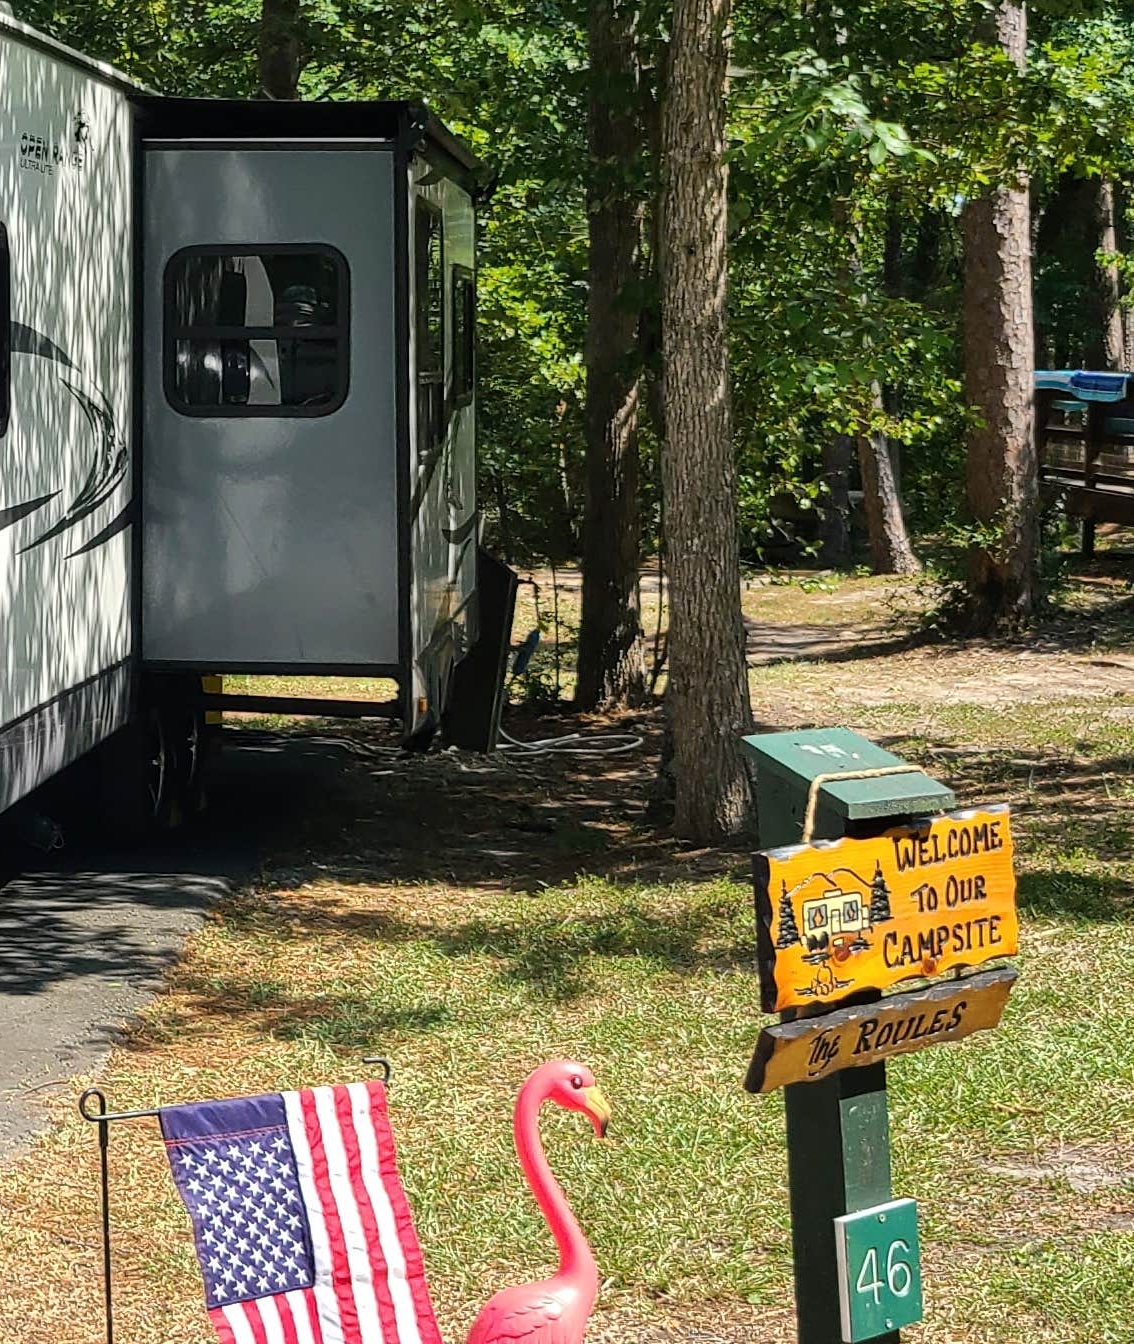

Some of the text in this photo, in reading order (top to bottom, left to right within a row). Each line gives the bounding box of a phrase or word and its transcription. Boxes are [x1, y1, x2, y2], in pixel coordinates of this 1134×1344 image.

[893, 820, 1003, 872] WELCOME
[911, 875, 986, 913] TO OUR
[883, 916, 1002, 968] CAMPSITE
[853, 1001, 967, 1055] ROULES
[855, 1239, 912, 1305] 46
